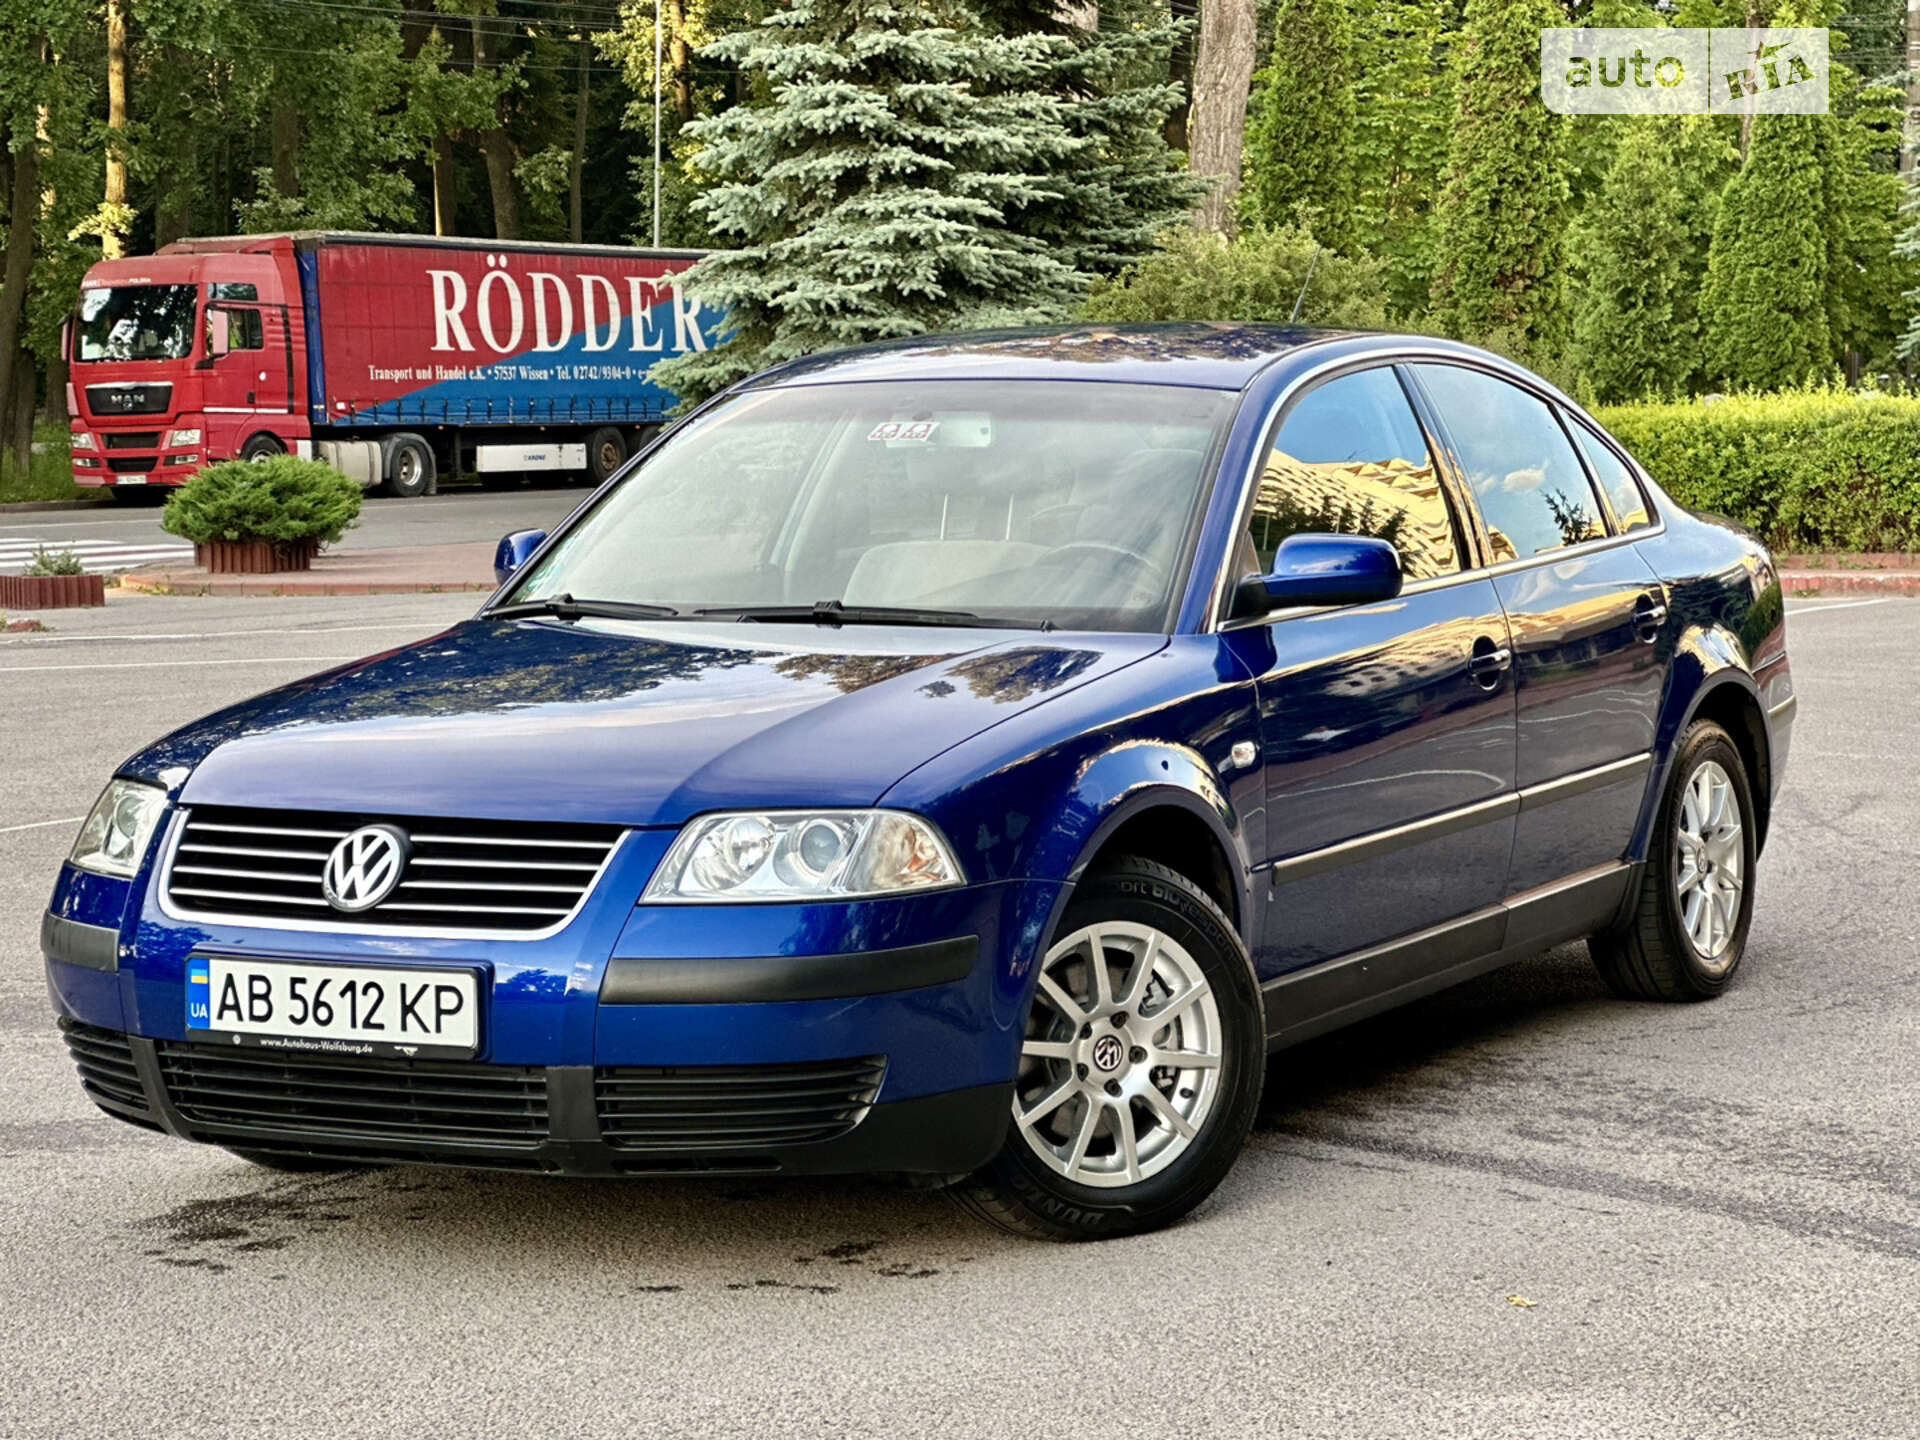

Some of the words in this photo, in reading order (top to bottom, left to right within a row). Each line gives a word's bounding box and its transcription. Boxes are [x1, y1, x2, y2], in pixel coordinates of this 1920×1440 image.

[426, 254, 708, 353] RÖDDER
[368, 364, 413, 383] Transport
[415, 364, 432, 380] und
[435, 364, 467, 380] Handel
[494, 365, 517, 380] 57537
[519, 365, 549, 380] Wissen
[556, 365, 571, 380] Tel.
[111, 394, 145, 404] MAN
[190, 1002, 208, 1018] UA
[216, 972, 274, 1023] AB
[288, 976, 386, 1030] 5612
[399, 982, 464, 1034] KP
[259, 1037, 374, 1055] www.Autohaus-Wolfsburg.de
